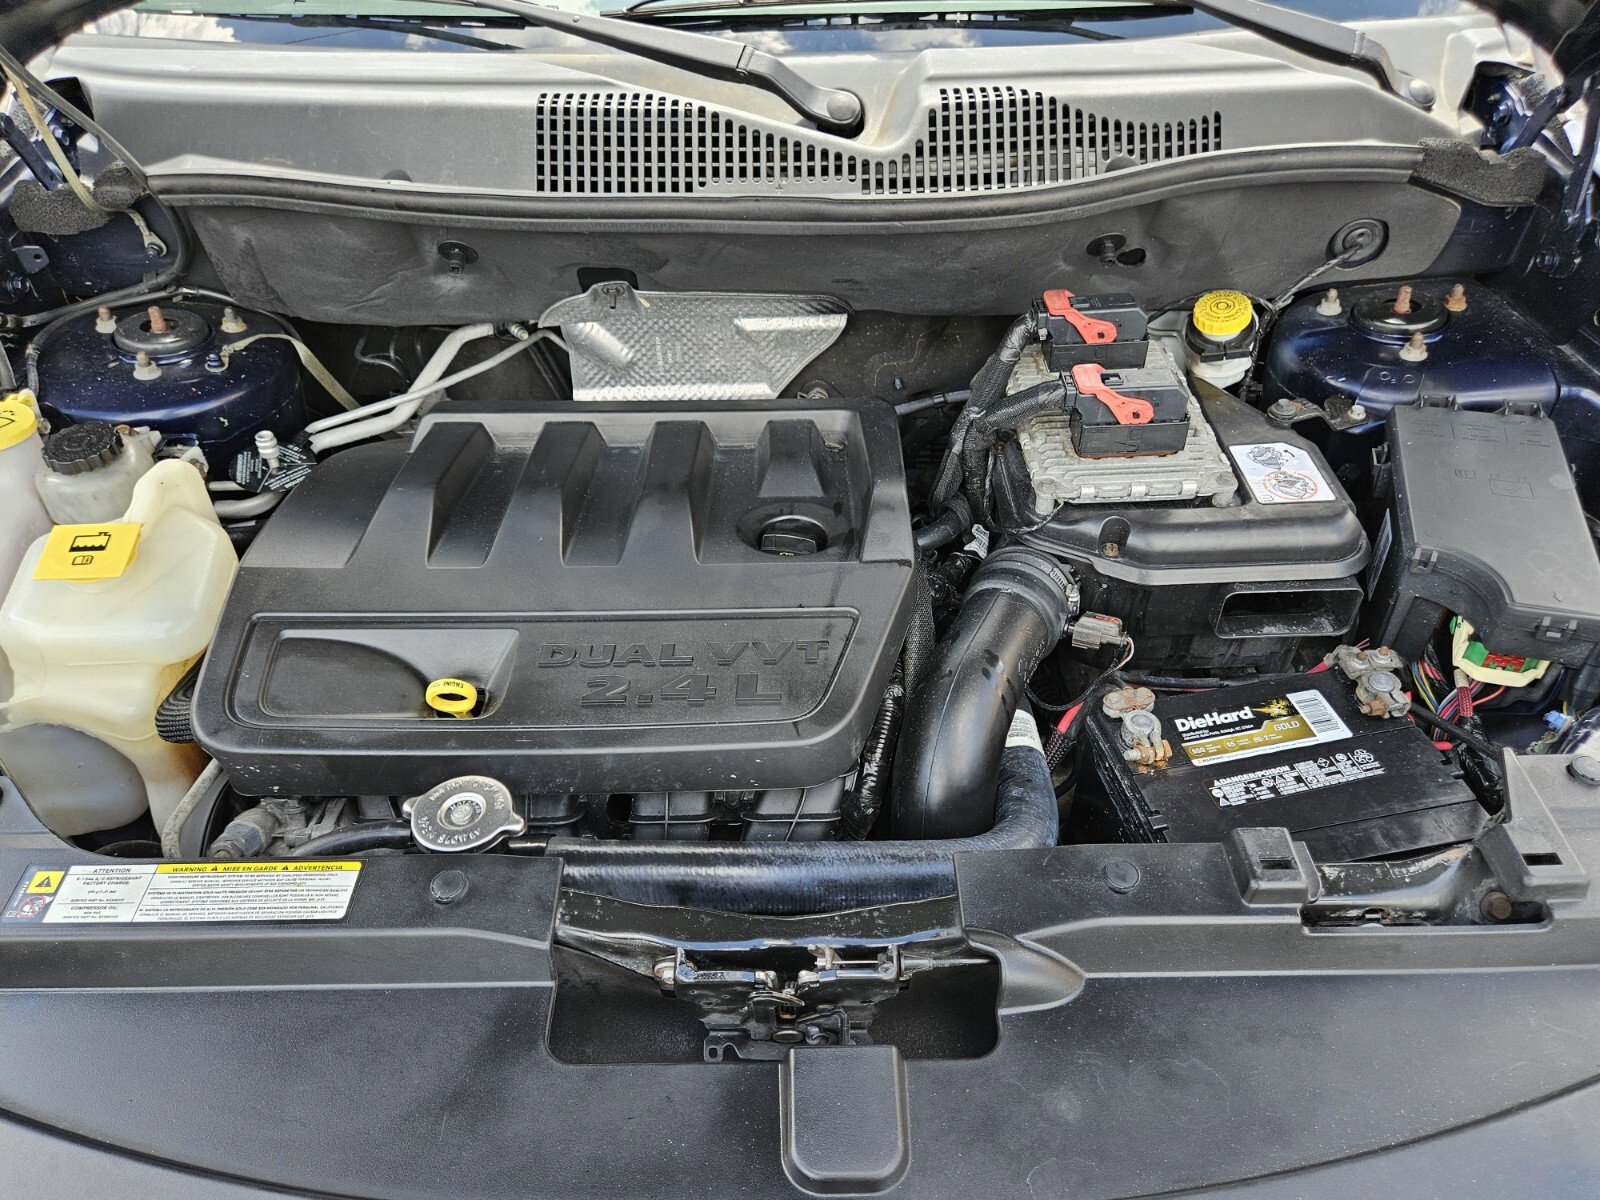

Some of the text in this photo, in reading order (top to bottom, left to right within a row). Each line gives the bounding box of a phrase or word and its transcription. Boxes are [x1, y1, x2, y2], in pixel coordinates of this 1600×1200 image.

[538, 640, 829, 668] DUAL VVT
[1174, 706, 1254, 732] DieHard
[1273, 721, 1300, 731] GOLD
[1219, 765, 1291, 785] DANGER/POISON
